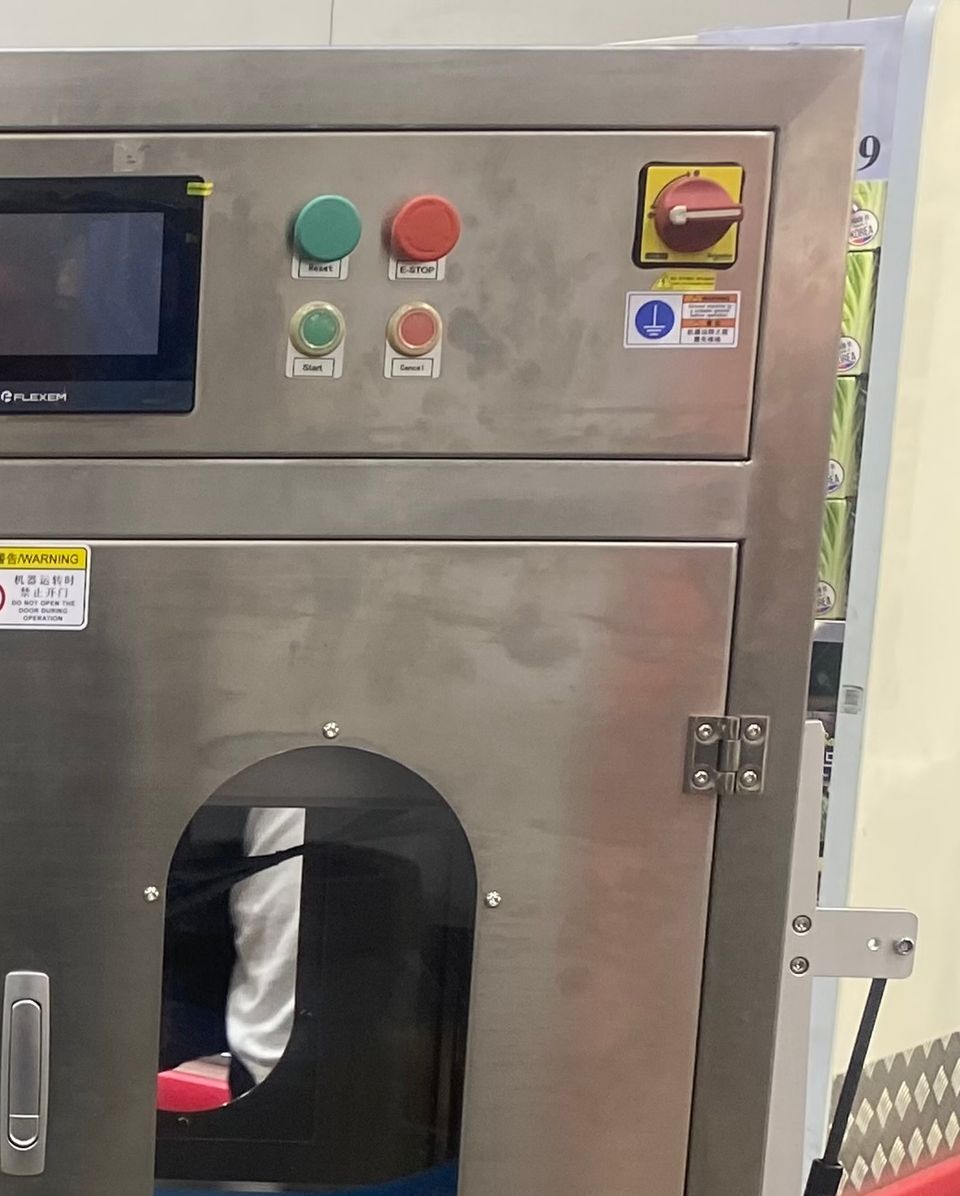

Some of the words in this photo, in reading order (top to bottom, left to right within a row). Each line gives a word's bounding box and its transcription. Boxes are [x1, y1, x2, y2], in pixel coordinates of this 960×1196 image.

[308, 264, 334, 272] Reset
[399, 266, 435, 274] E-STOP
[302, 363, 323, 372] Start
[399, 363, 425, 372] Cancel
[13, 392, 67, 402] FLEXEM
[14, 574, 74, 586] 机器运转时
[20, 587, 69, 598] 禁止开门
